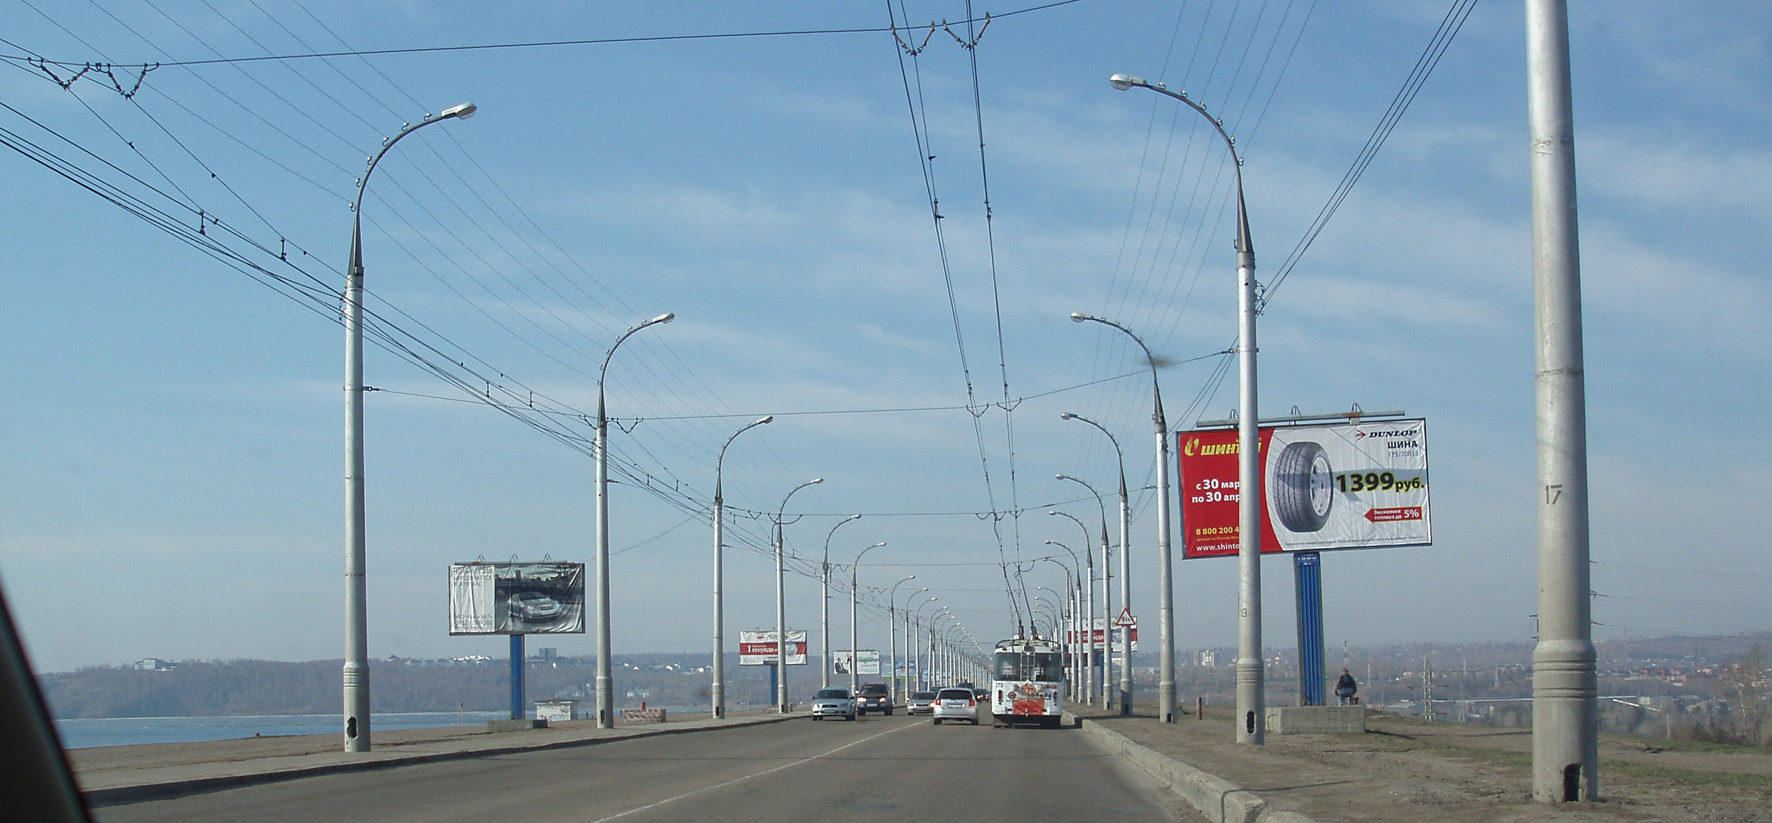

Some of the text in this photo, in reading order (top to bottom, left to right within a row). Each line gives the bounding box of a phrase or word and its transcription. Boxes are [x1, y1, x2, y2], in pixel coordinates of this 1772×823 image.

[1369, 430, 1417, 438] DUNLOP
[1387, 440, 1418, 449] ШИНА
[1203, 478, 1219, 490] 30
[1221, 481, 1239, 490] мар
[1336, 471, 1425, 493] 1399 руб.
[1192, 491, 1239, 503] по 30 апр
[1545, 484, 1562, 505] 17
[1404, 508, 1420, 518] 5%
[1202, 527, 1217, 535] 800
[1218, 526, 1233, 534] 200
[1196, 543, 1239, 551] www.shinto
